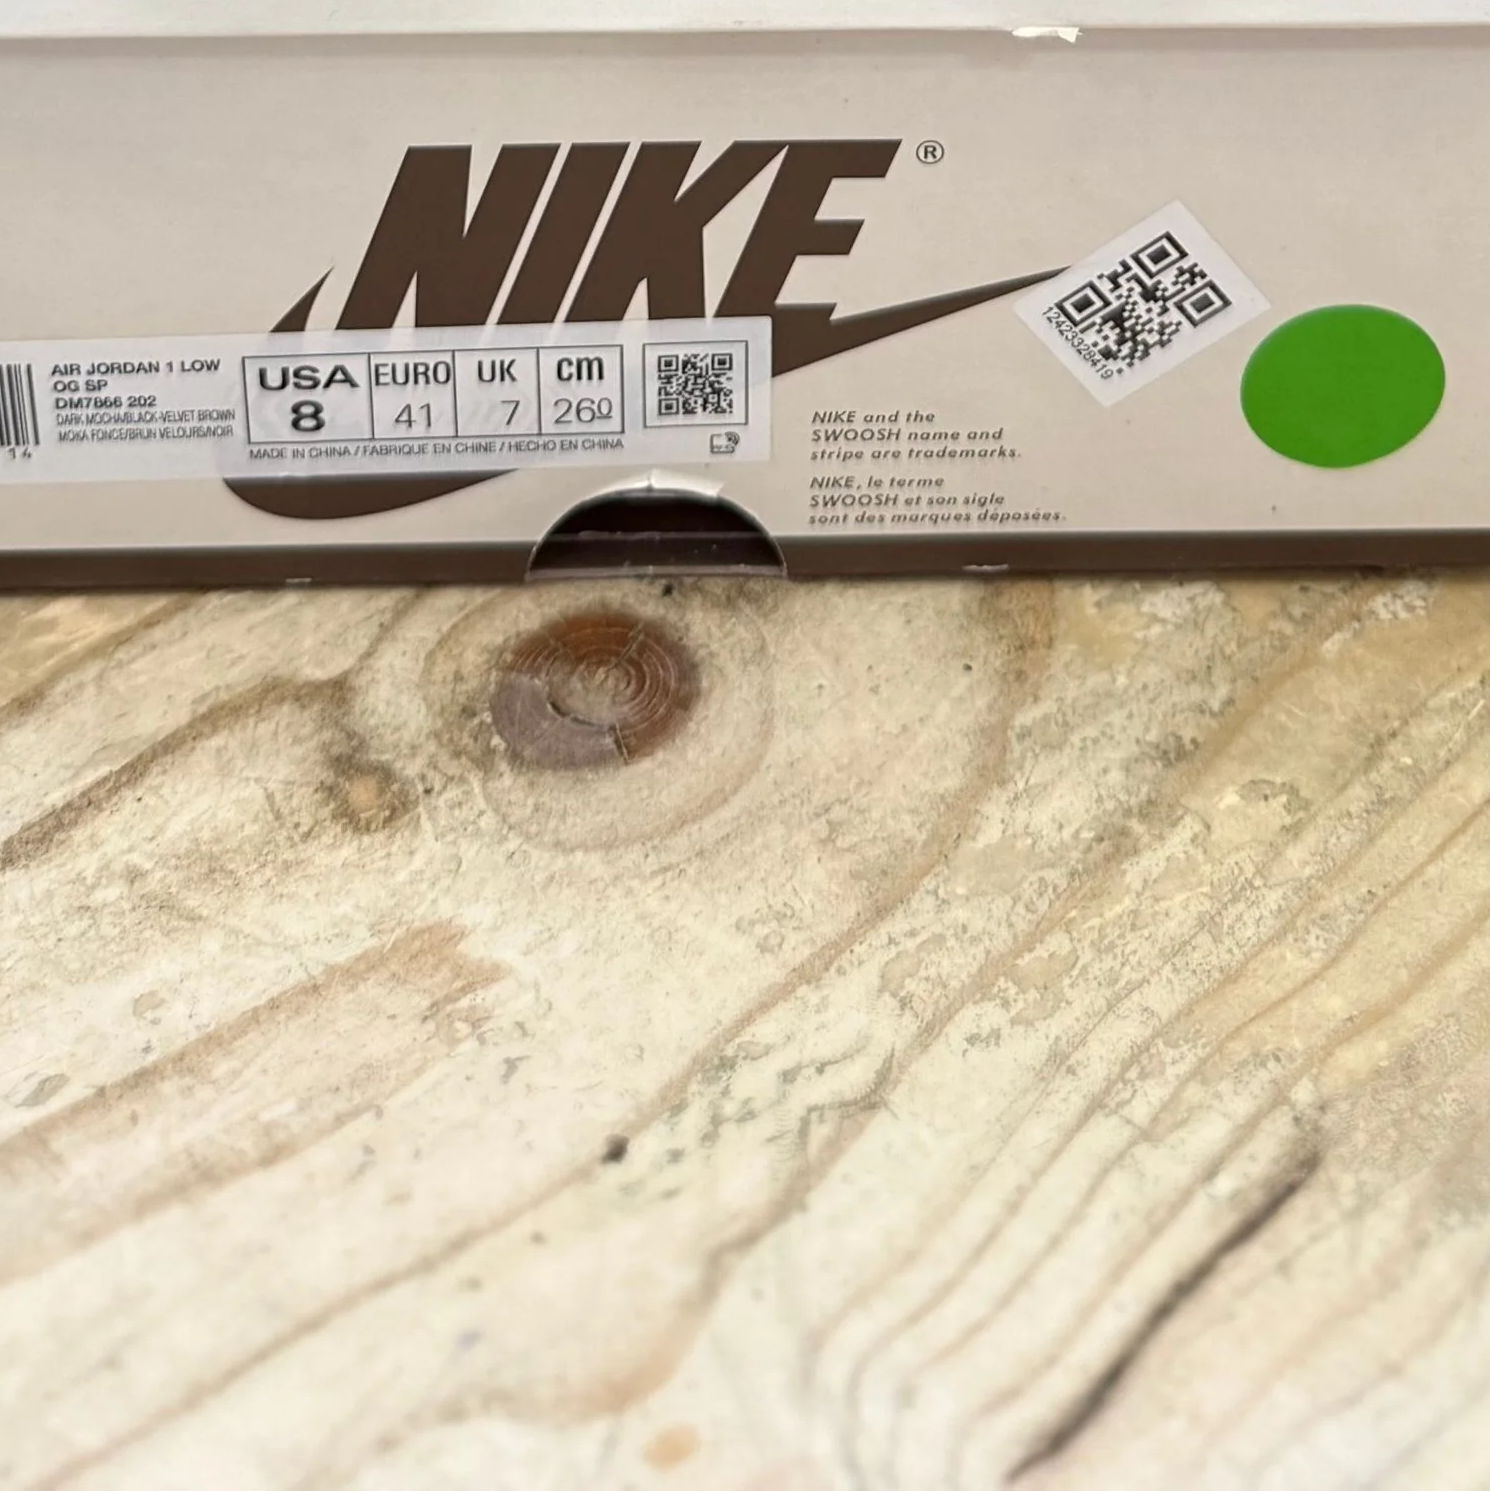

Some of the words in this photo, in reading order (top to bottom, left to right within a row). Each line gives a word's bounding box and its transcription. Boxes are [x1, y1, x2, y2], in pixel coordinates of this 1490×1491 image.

[335, 138, 902, 330] NIKE
[51, 362, 82, 377] AIR
[86, 361, 160, 376] JORDAN
[166, 360, 175, 373] 1
[180, 358, 221, 372] LOW
[257, 363, 361, 391] USA
[373, 360, 451, 388] EURO
[477, 358, 518, 383] UK
[556, 355, 605, 382] cm
[53, 379, 80, 392] OG
[84, 378, 109, 392] SP
[55, 396, 123, 410] DM7866
[127, 394, 157, 408] 202
[56, 413, 84, 425] DARK
[198, 408, 236, 422] BROWN
[289, 398, 326, 433] 8
[394, 402, 433, 429] 41
[500, 399, 521, 426] 7
[812, 410, 857, 424] NIKE
[863, 410, 900, 424] and
[906, 410, 936, 423] the
[811, 428, 901, 442] SWOOSH
[907, 429, 961, 442] name
[967, 427, 1004, 441] and
[8, 446, 33, 459] 14
[249, 448, 287, 460] MADE
[292, 448, 306, 459] IN
[309, 446, 352, 459] CHINA
[363, 443, 429, 456] FABRIQUE
[432, 442, 451, 455] EN
[454, 441, 496, 454] CHINE
[508, 439, 557, 452] HECHO
[560, 439, 578, 451] EN
[581, 438, 624, 450] CHINA
[810, 446, 864, 462] stripe
[871, 449, 901, 460] are
[907, 446, 1022, 460] trademarks.
[810, 476, 861, 490] NIKE,
[867, 475, 884, 489] le
[888, 476, 945, 489] terme
[810, 493, 899, 508] SWOOSH
[904, 494, 923, 507] et
[926, 495, 957, 507] son
[962, 492, 1005, 508] sigle
[808, 512, 849, 526] sont
[854, 510, 886, 524] des
[891, 512, 972, 526] marques
[977, 507, 1068, 523] déposées.
